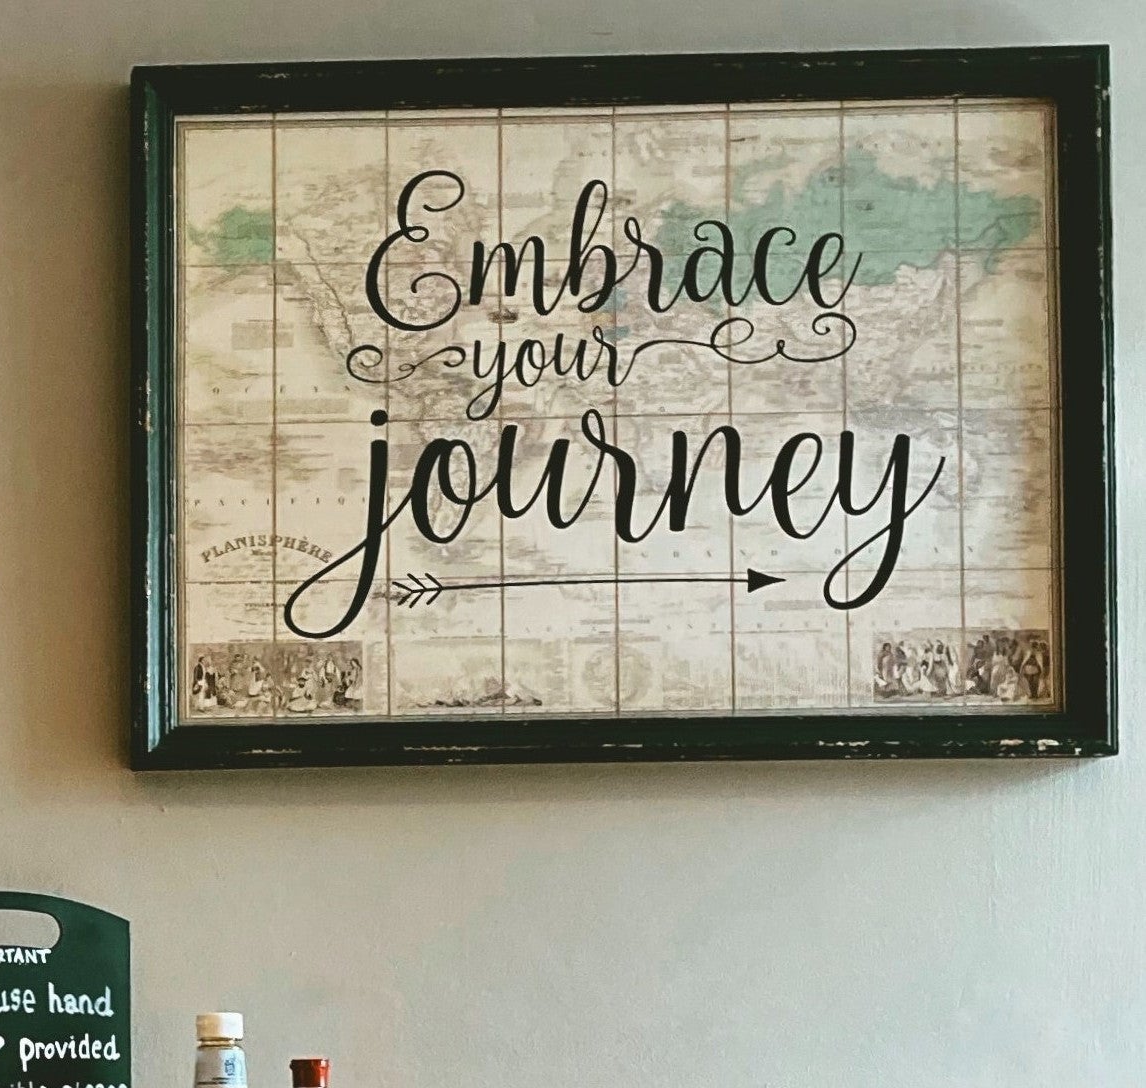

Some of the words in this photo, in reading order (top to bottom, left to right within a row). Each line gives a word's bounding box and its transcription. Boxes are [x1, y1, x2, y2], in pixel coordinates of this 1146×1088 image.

[365, 169, 862, 332] Embrace
[466, 325, 638, 421] your
[285, 409, 946, 639] journey
[47, 981, 115, 1017] hand
[19, 1033, 121, 1072] provided
